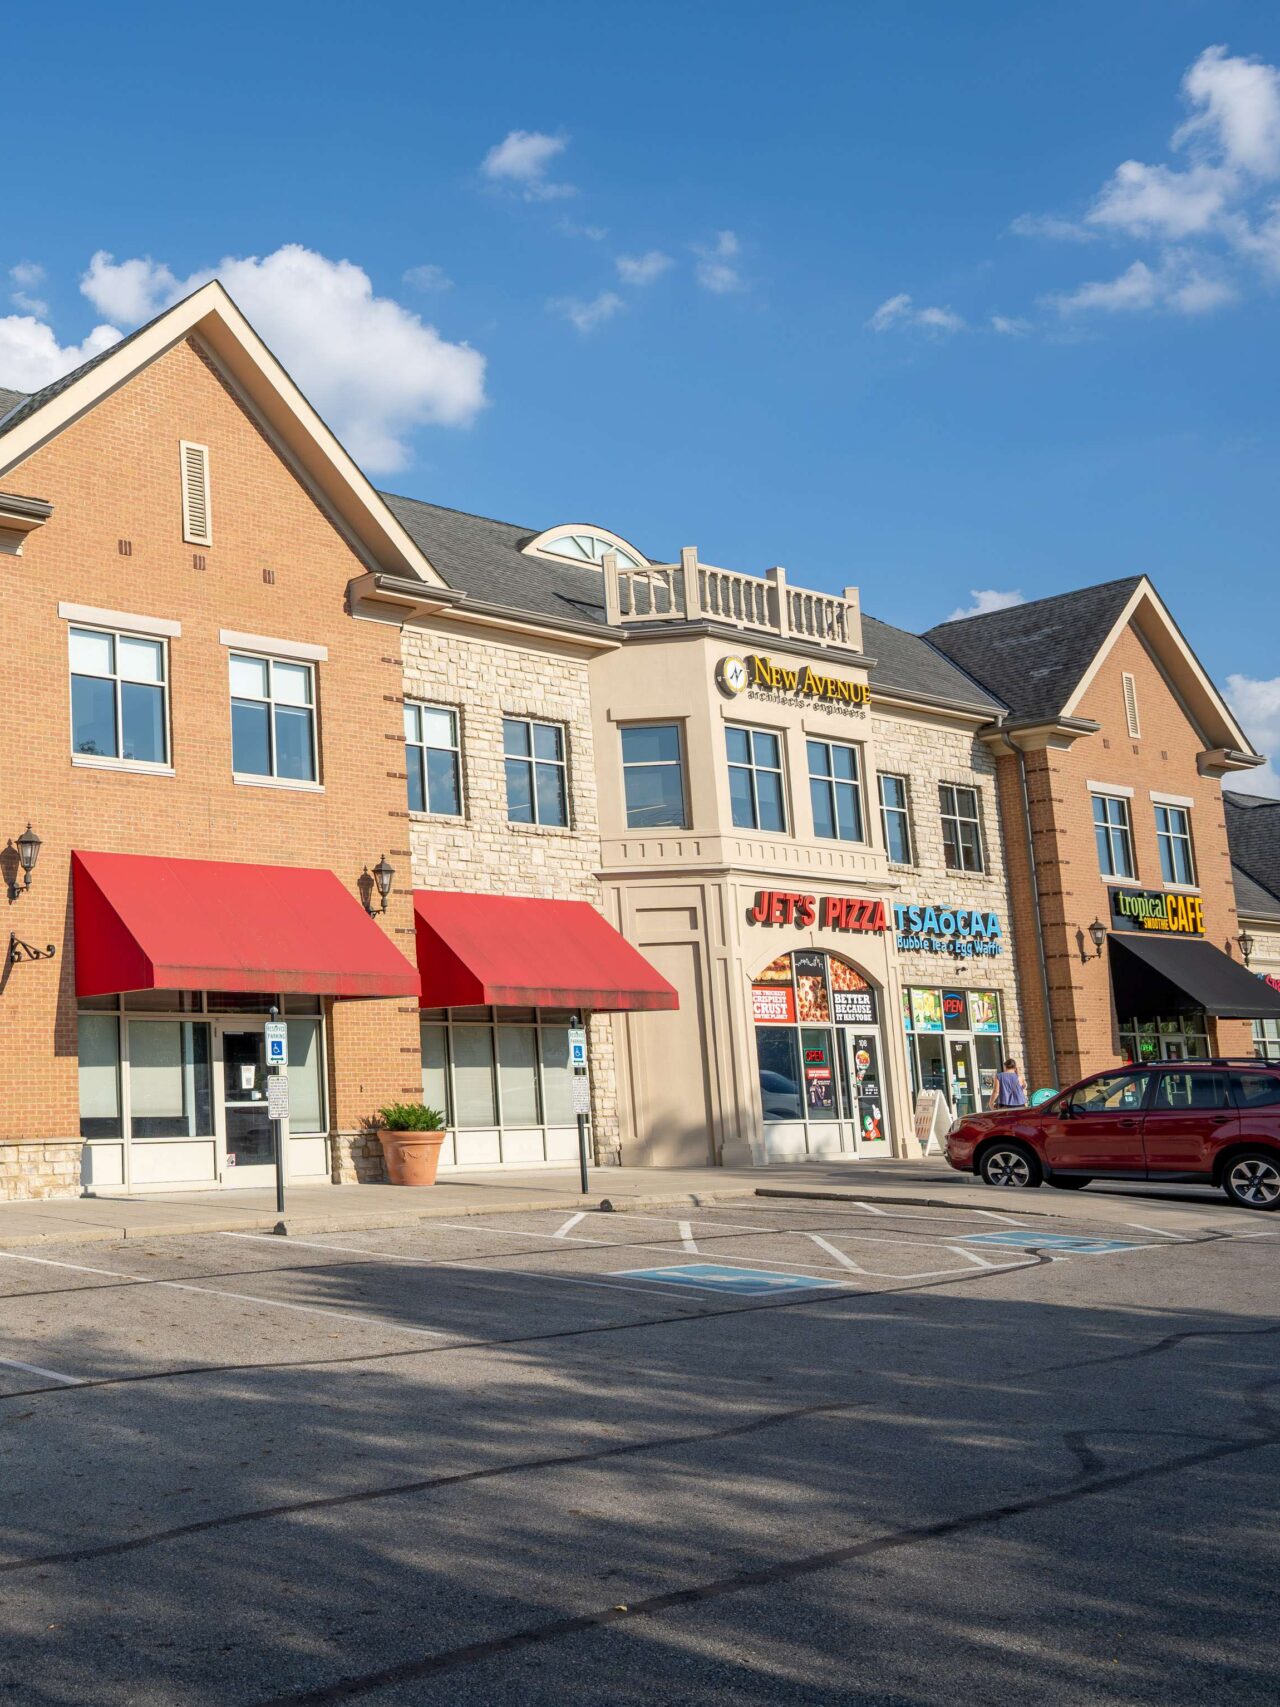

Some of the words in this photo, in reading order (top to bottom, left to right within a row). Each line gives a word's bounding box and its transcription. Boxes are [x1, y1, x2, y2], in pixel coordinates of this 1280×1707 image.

[747, 690, 805, 709] architects
[813, 702, 867, 720] engineers
[752, 891, 816, 926] JET'S
[825, 896, 887, 931] PIZZA
[1119, 891, 1168, 922] tropical
[1166, 895, 1206, 933] CAFE
[896, 934, 929, 951] Bubble
[931, 938, 947, 952] Tea
[955, 940, 973, 957] Egg
[974, 939, 1004, 955] Waffle
[754, 1003, 787, 1014] CRUST
[834, 993, 870, 1004] BETTER
[835, 1004, 872, 1013] BECAUSE
